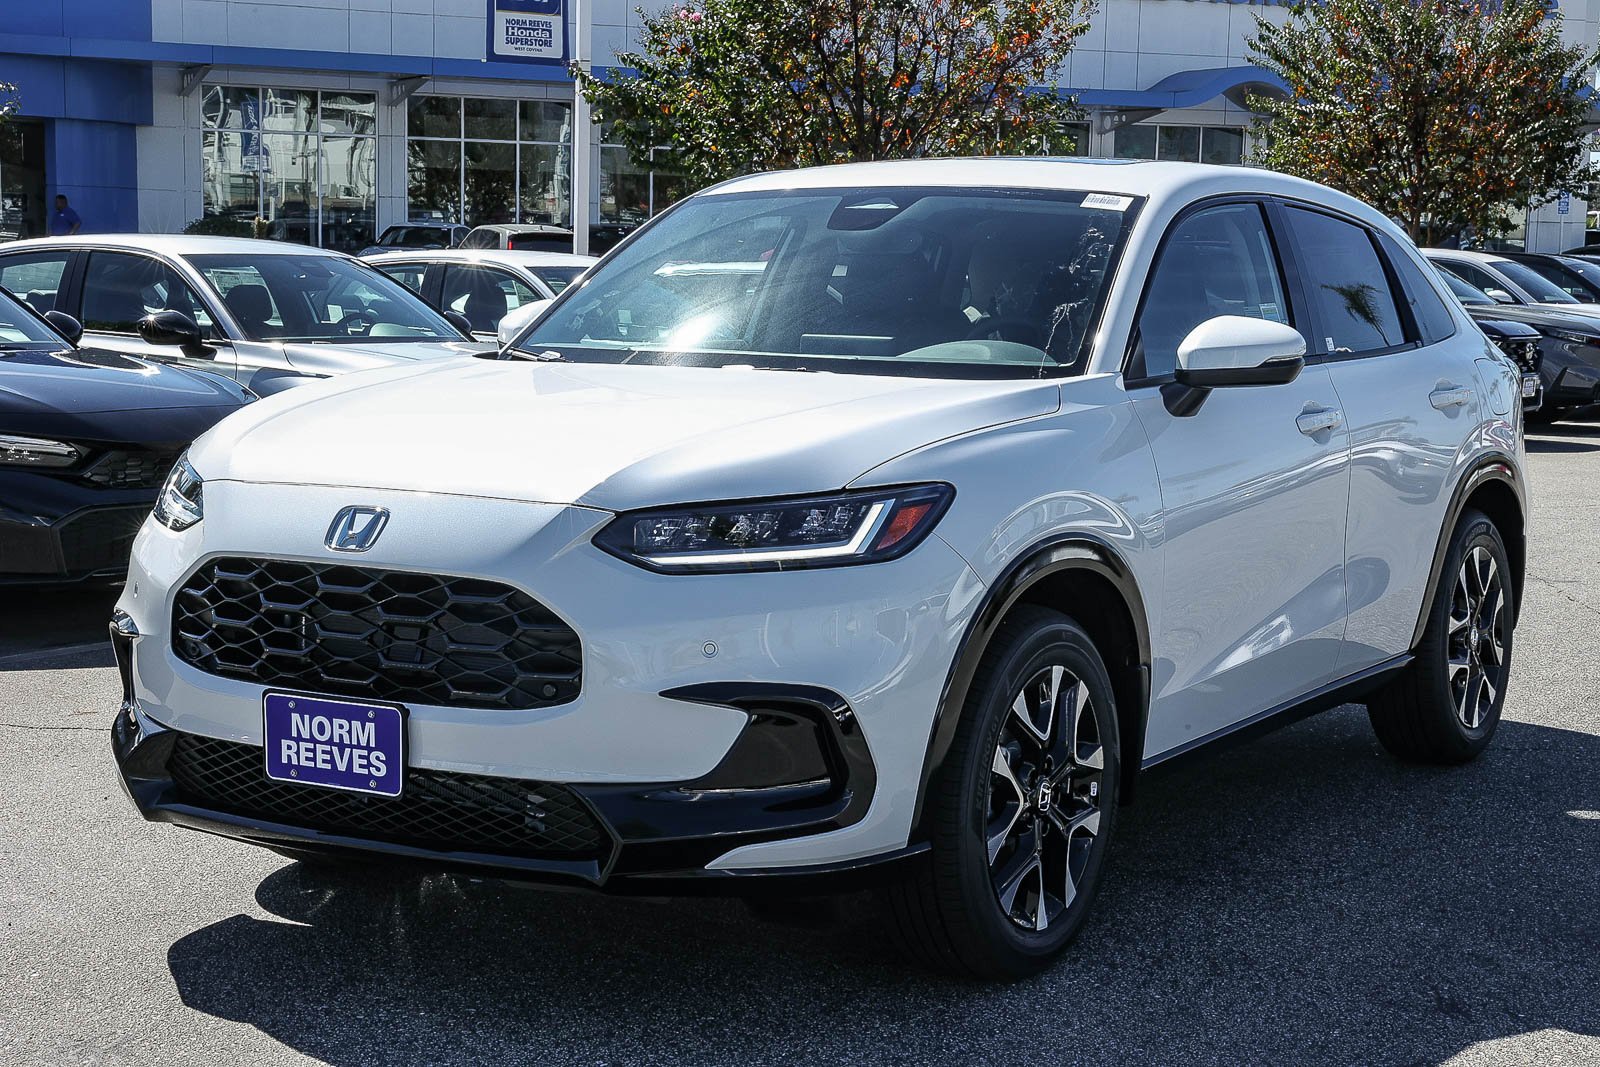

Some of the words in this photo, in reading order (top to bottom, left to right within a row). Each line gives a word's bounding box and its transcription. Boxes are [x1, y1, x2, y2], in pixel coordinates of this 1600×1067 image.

[505, 18, 528, 27] NORM
[528, 20, 552, 28] REEVES
[508, 26, 550, 38] Honda
[505, 36, 552, 48] SUPERSTORE
[291, 712, 376, 748] NORM
[281, 739, 387, 777] REEVES
